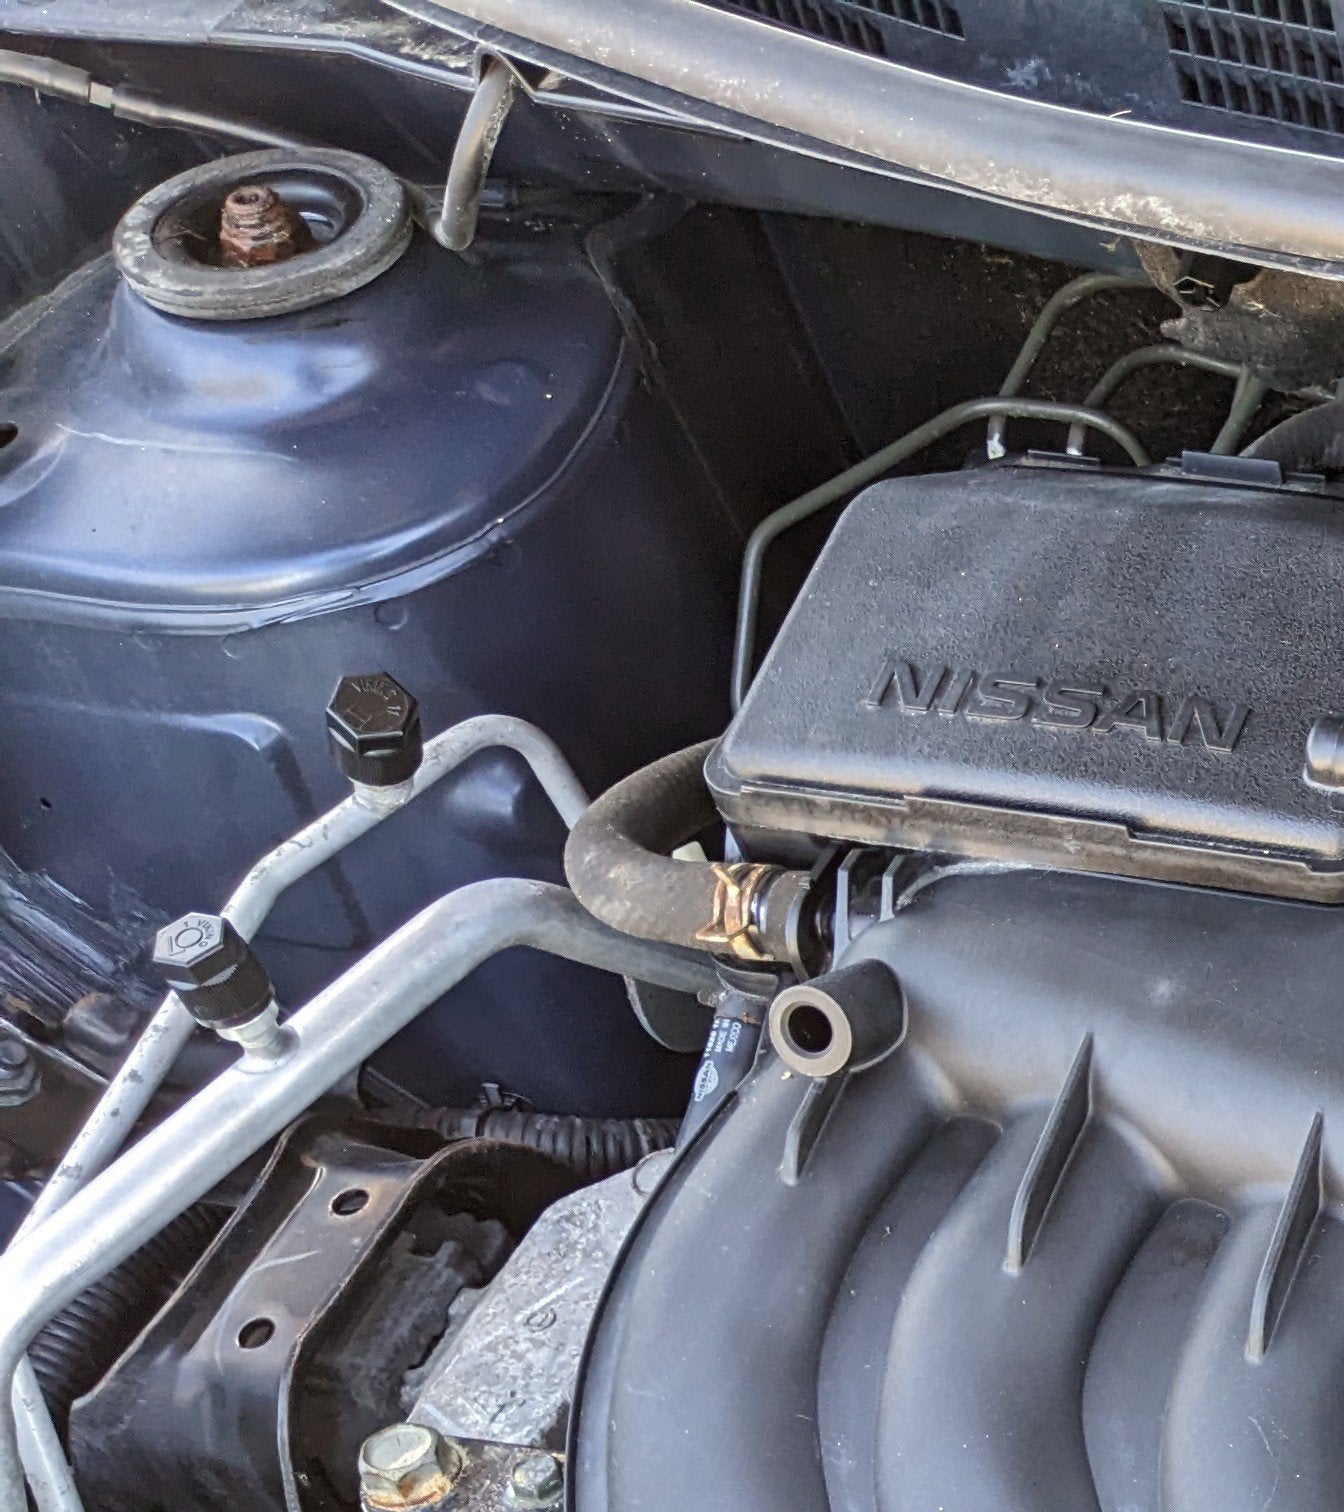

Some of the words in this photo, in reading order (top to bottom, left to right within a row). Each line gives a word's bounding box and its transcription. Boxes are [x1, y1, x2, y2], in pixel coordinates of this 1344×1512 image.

[866, 659, 1253, 753] NISSAN
[714, 1030, 727, 1052] MADE
[725, 1021, 742, 1052] MEXICO
[696, 1061, 711, 1099] NISSAN
